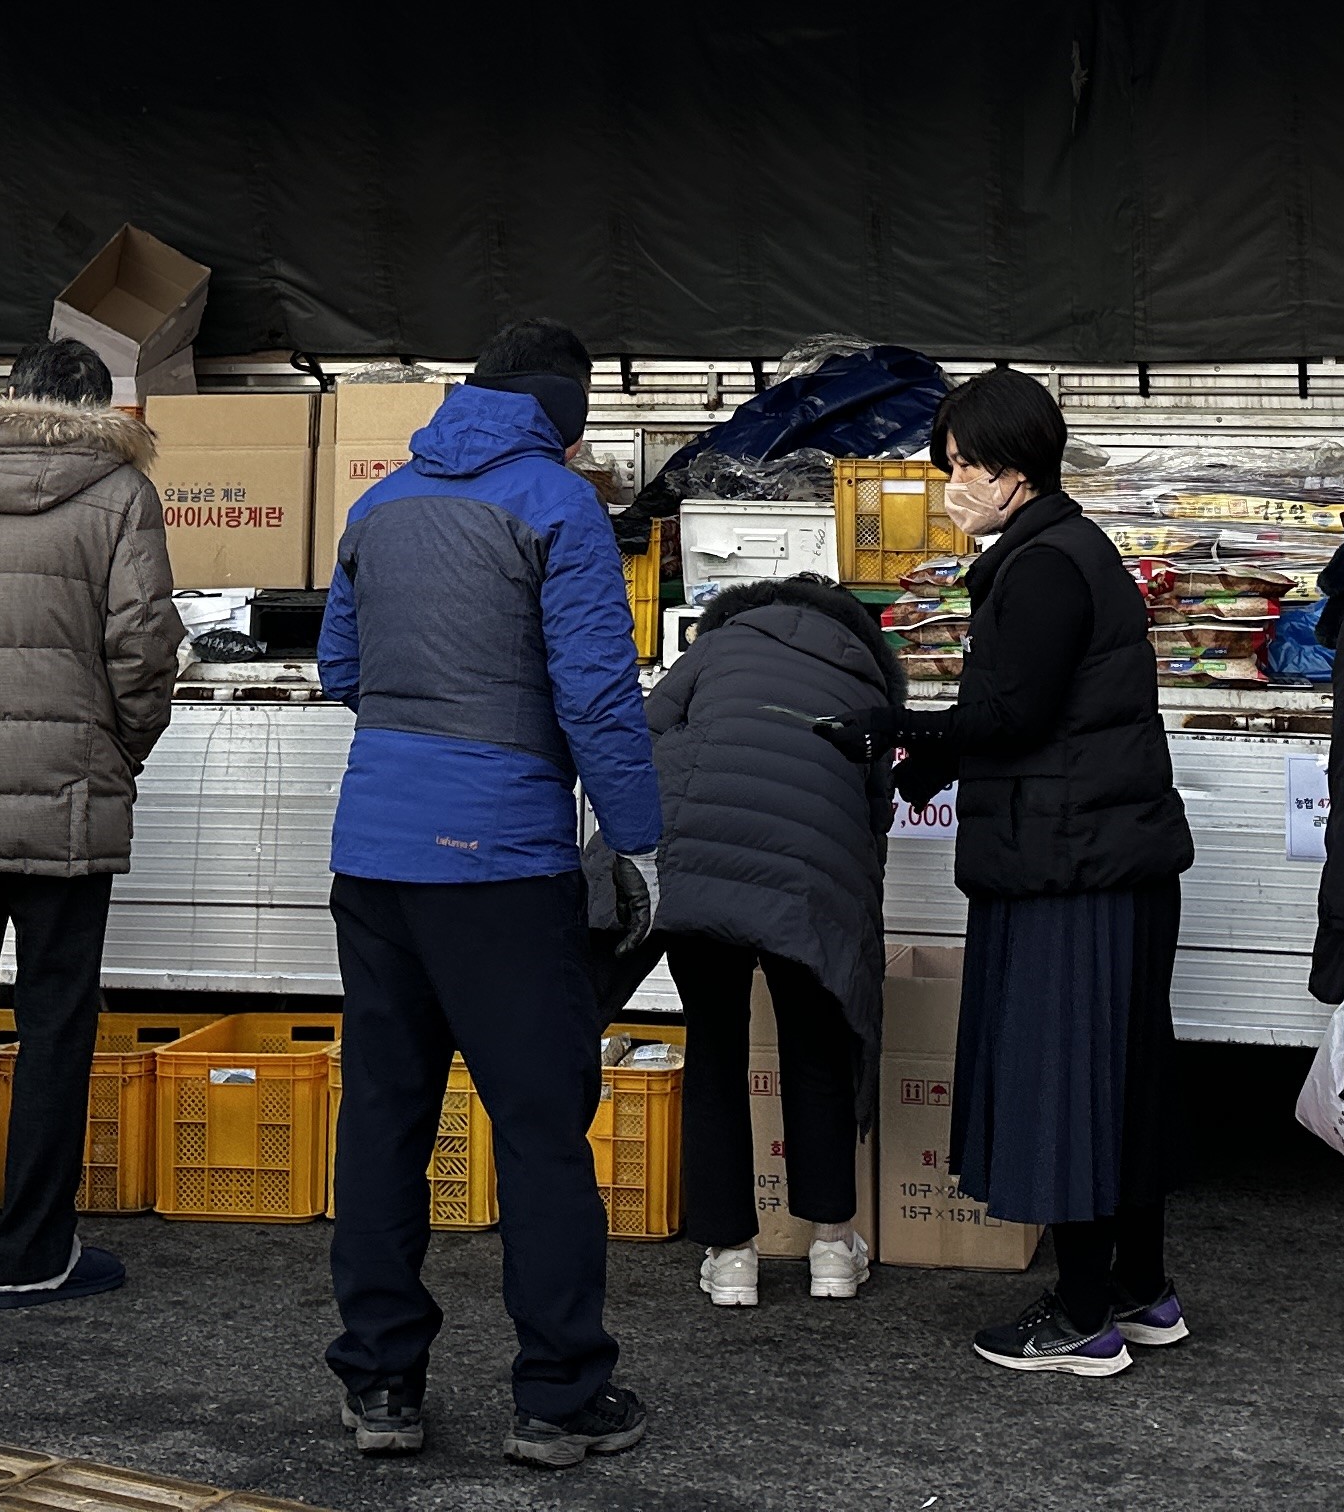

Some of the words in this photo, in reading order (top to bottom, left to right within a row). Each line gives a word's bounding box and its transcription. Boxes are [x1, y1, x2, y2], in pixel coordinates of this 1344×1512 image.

[164, 488, 216, 503] 오늘낳은
[220, 488, 246, 503] 계란
[164, 506, 285, 528] 아이사랑계란
[1295, 797, 1314, 809] 농협
